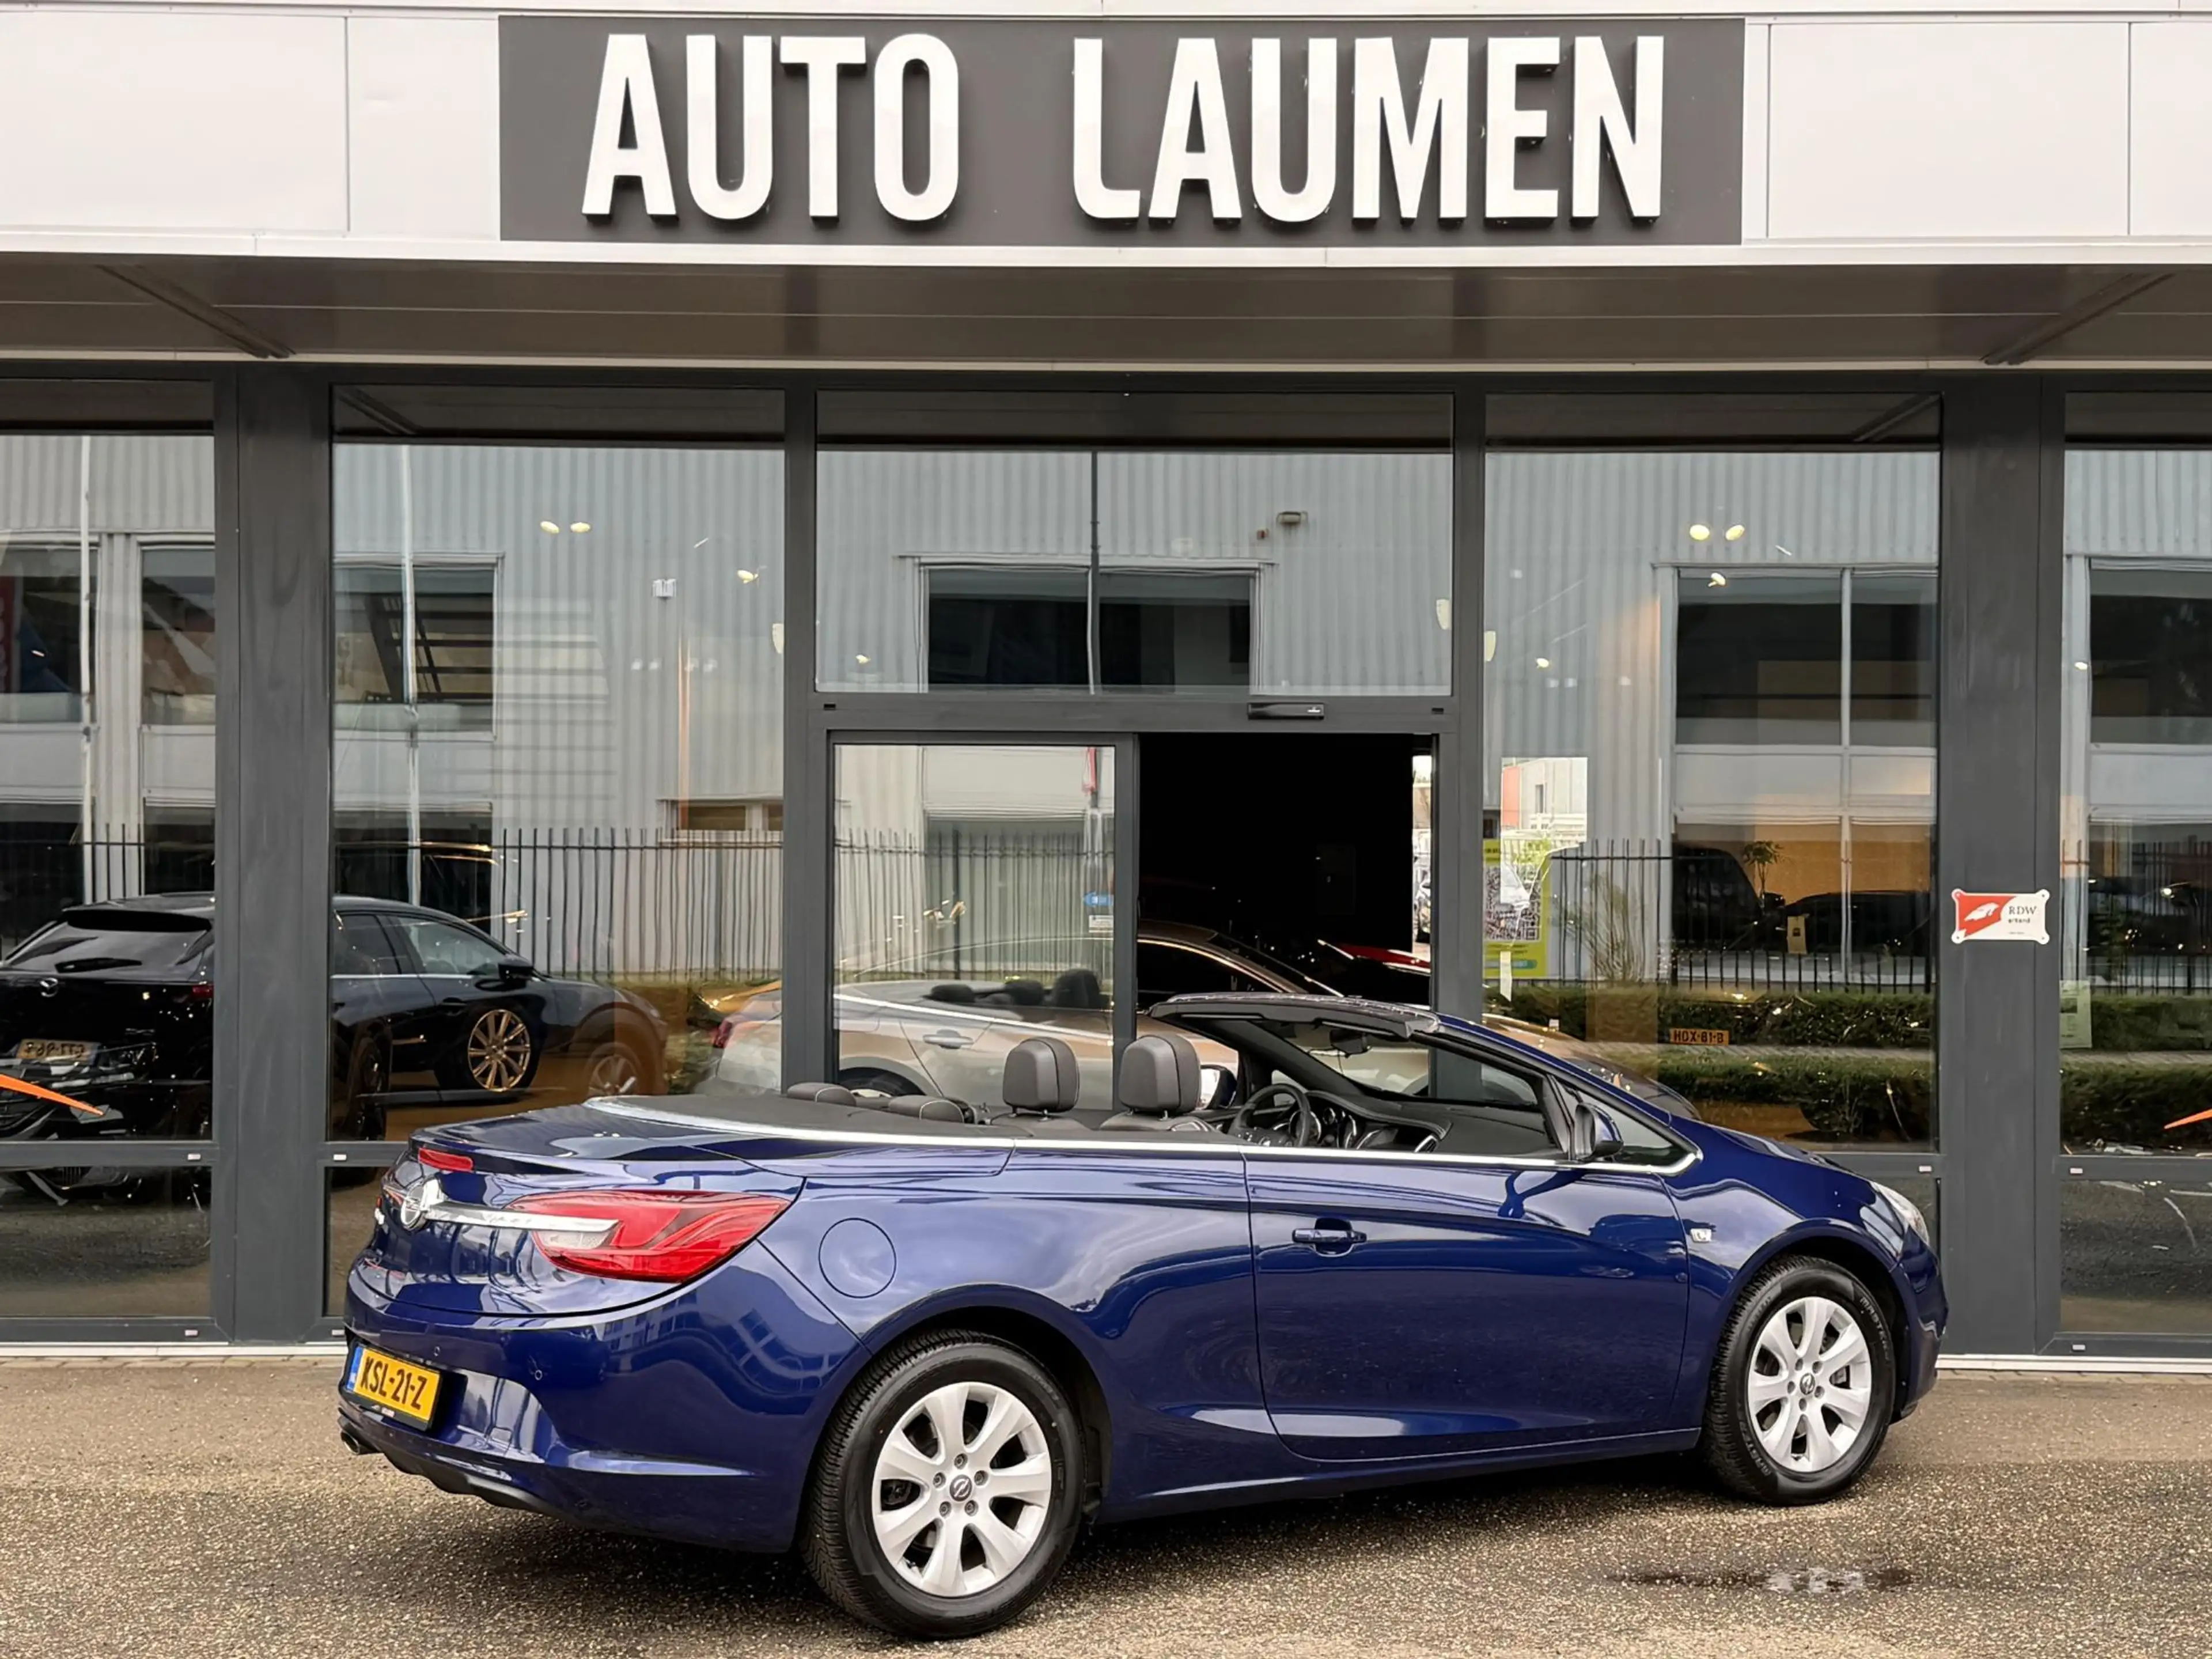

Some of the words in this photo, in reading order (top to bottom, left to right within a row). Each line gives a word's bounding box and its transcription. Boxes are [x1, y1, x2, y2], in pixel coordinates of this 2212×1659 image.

[582, 33, 959, 221] AUTO
[1074, 35, 1664, 222] LAUMEN
[2008, 906, 2037, 915] RDW
[361, 1356, 428, 1411] KSL-21-Z
